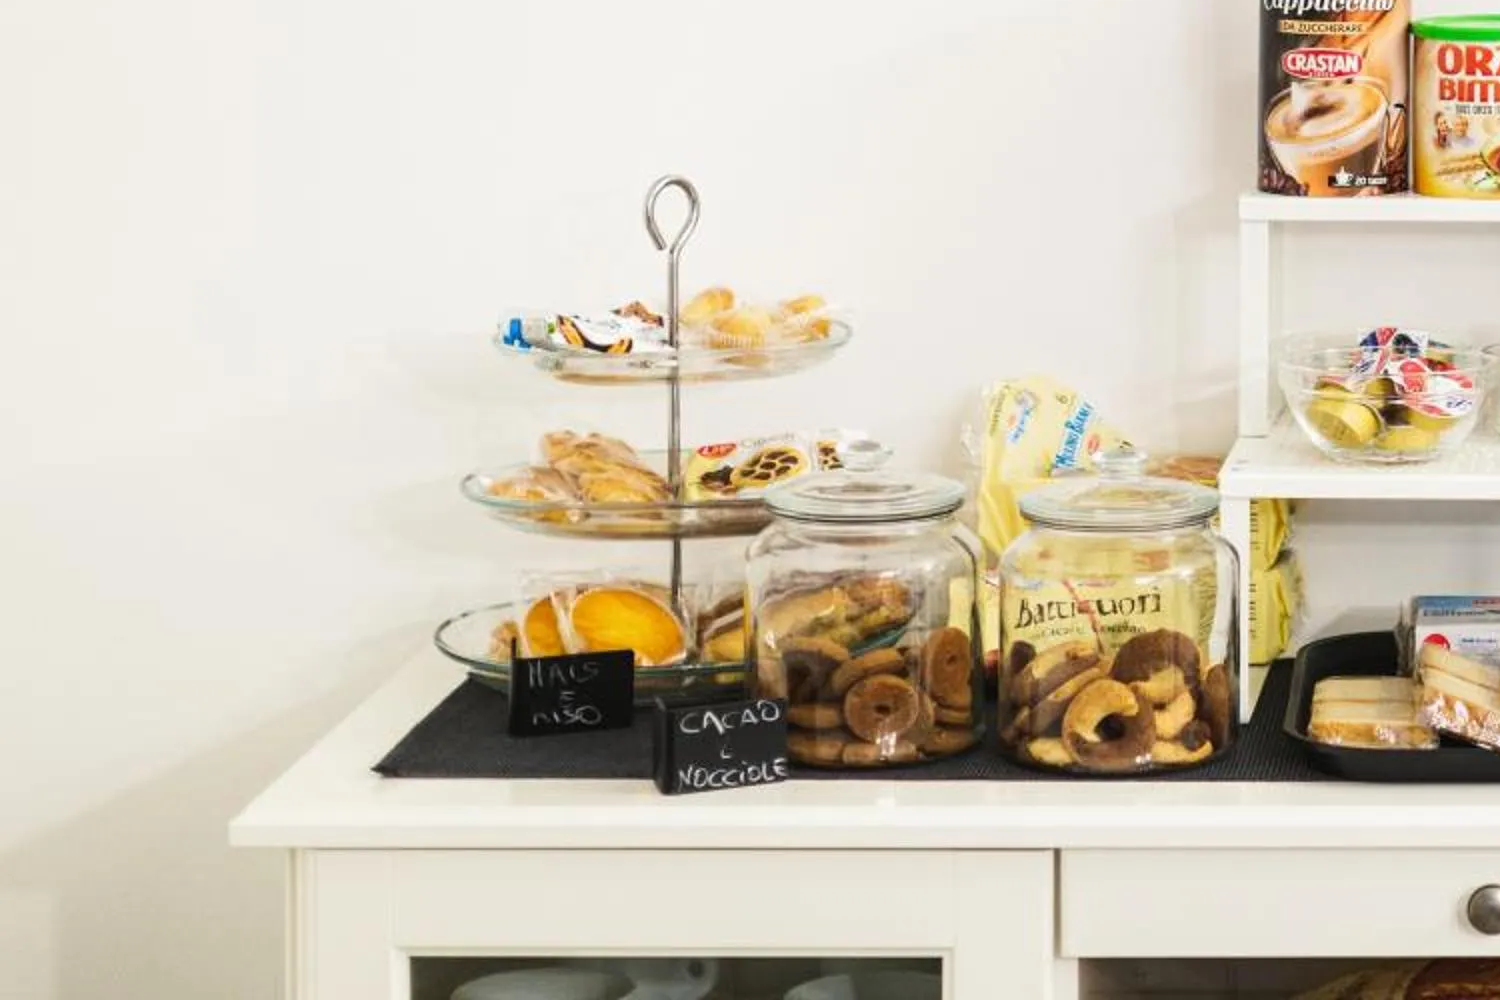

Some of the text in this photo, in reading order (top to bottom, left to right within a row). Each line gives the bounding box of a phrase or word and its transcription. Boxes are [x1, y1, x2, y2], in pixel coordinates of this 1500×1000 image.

[1286, 53, 1359, 74] CRASTAN
[1014, 585, 1162, 629] Battiuori
[679, 700, 780, 735] CACAO
